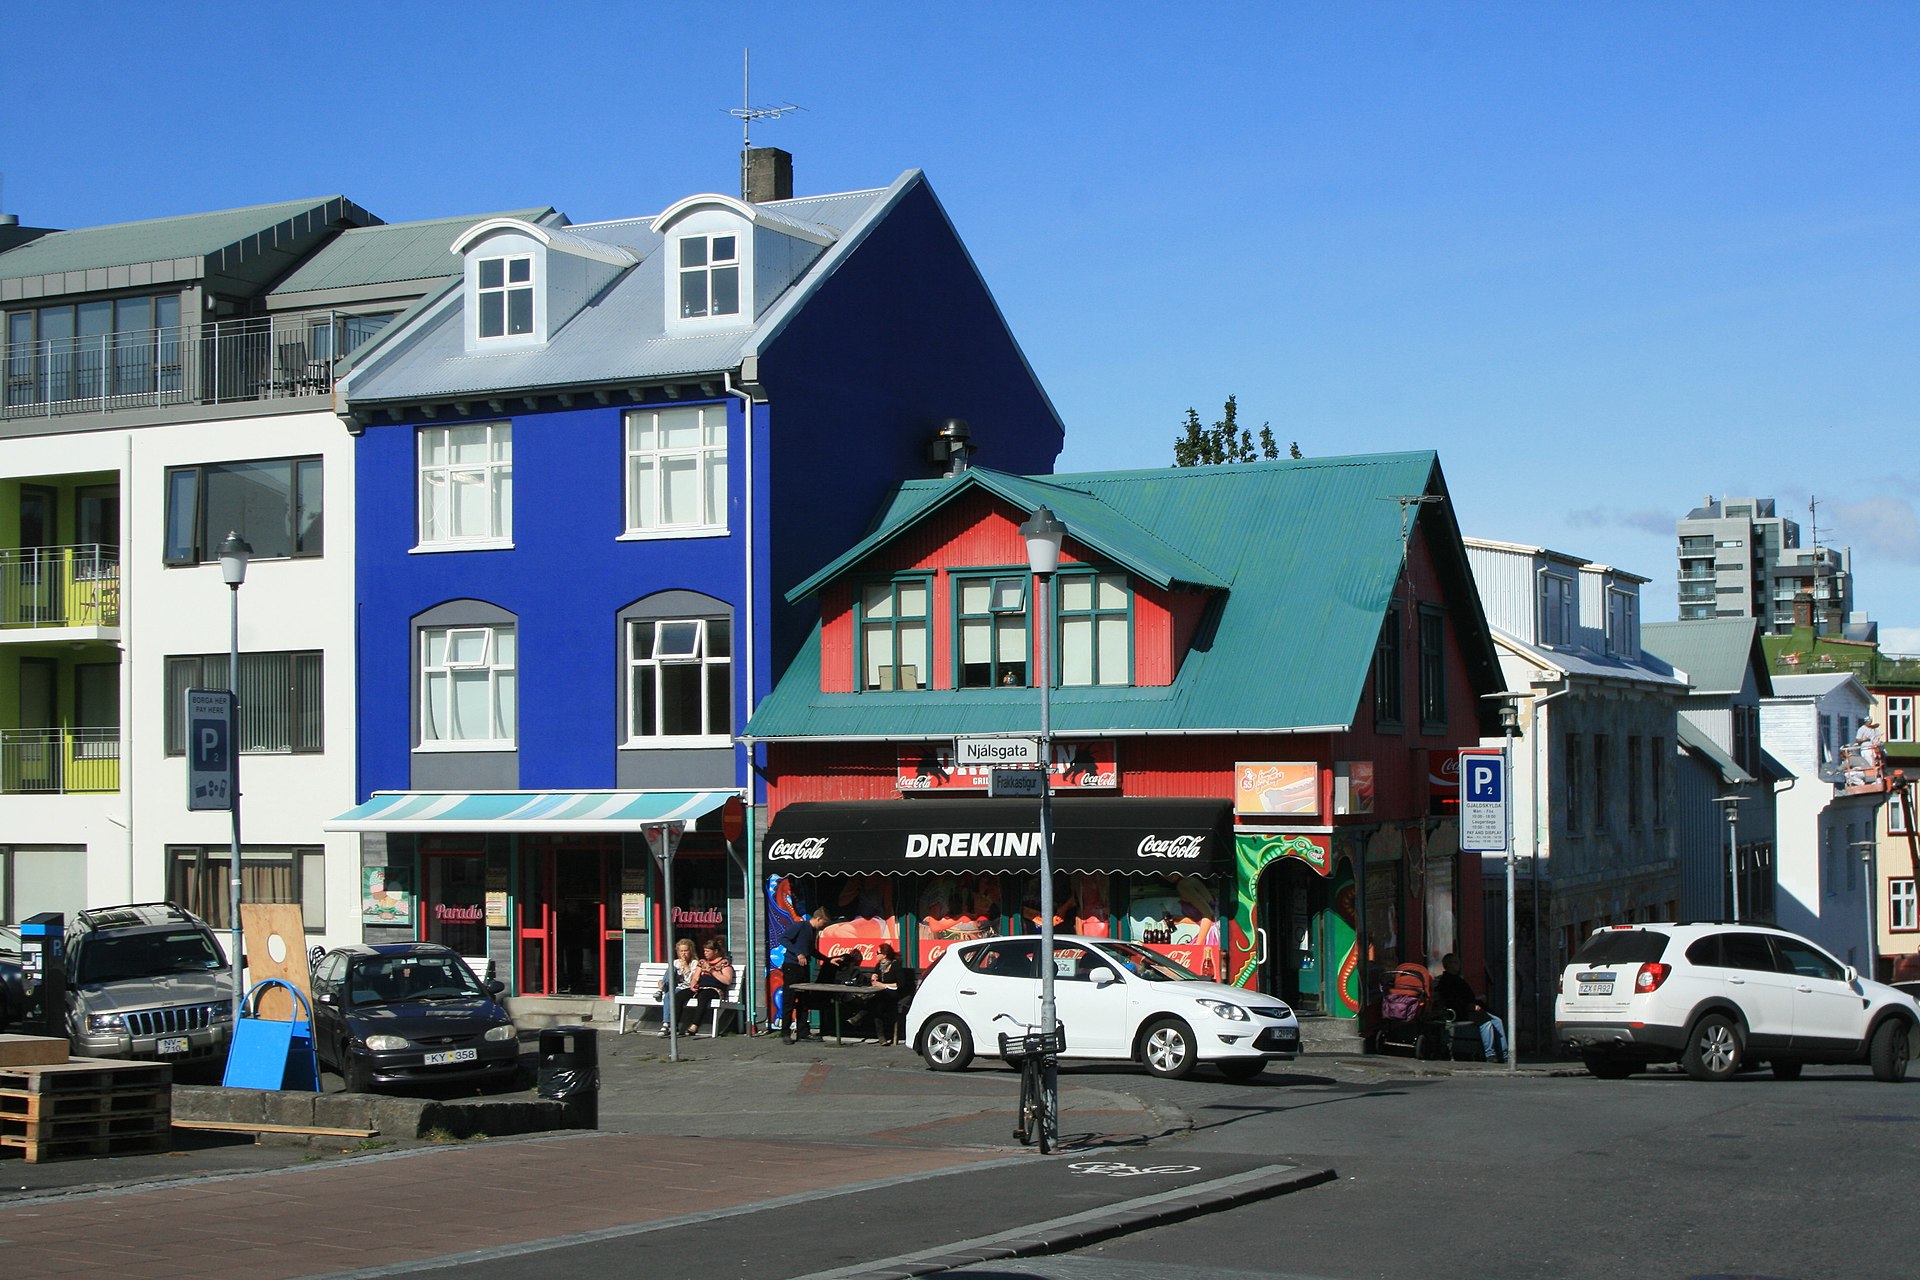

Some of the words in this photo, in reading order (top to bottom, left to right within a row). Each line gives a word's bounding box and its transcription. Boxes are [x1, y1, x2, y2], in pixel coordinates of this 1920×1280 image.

[208, 706, 224, 714] HERE
[201, 728, 218, 761] P
[967, 744, 1028, 759] Njálsgata
[214, 752, 219, 762] 2
[1242, 780, 1253, 789] SS
[1475, 767, 1493, 795] P
[1487, 787, 1493, 795] 2
[768, 837, 829, 861] Coca-Cola
[1137, 834, 1206, 859] Coca-Cola
[435, 904, 483, 919] Paradís
[671, 907, 723, 923] Paradís
[431, 1053, 446, 1063] KY
[455, 1050, 475, 1060] 358
